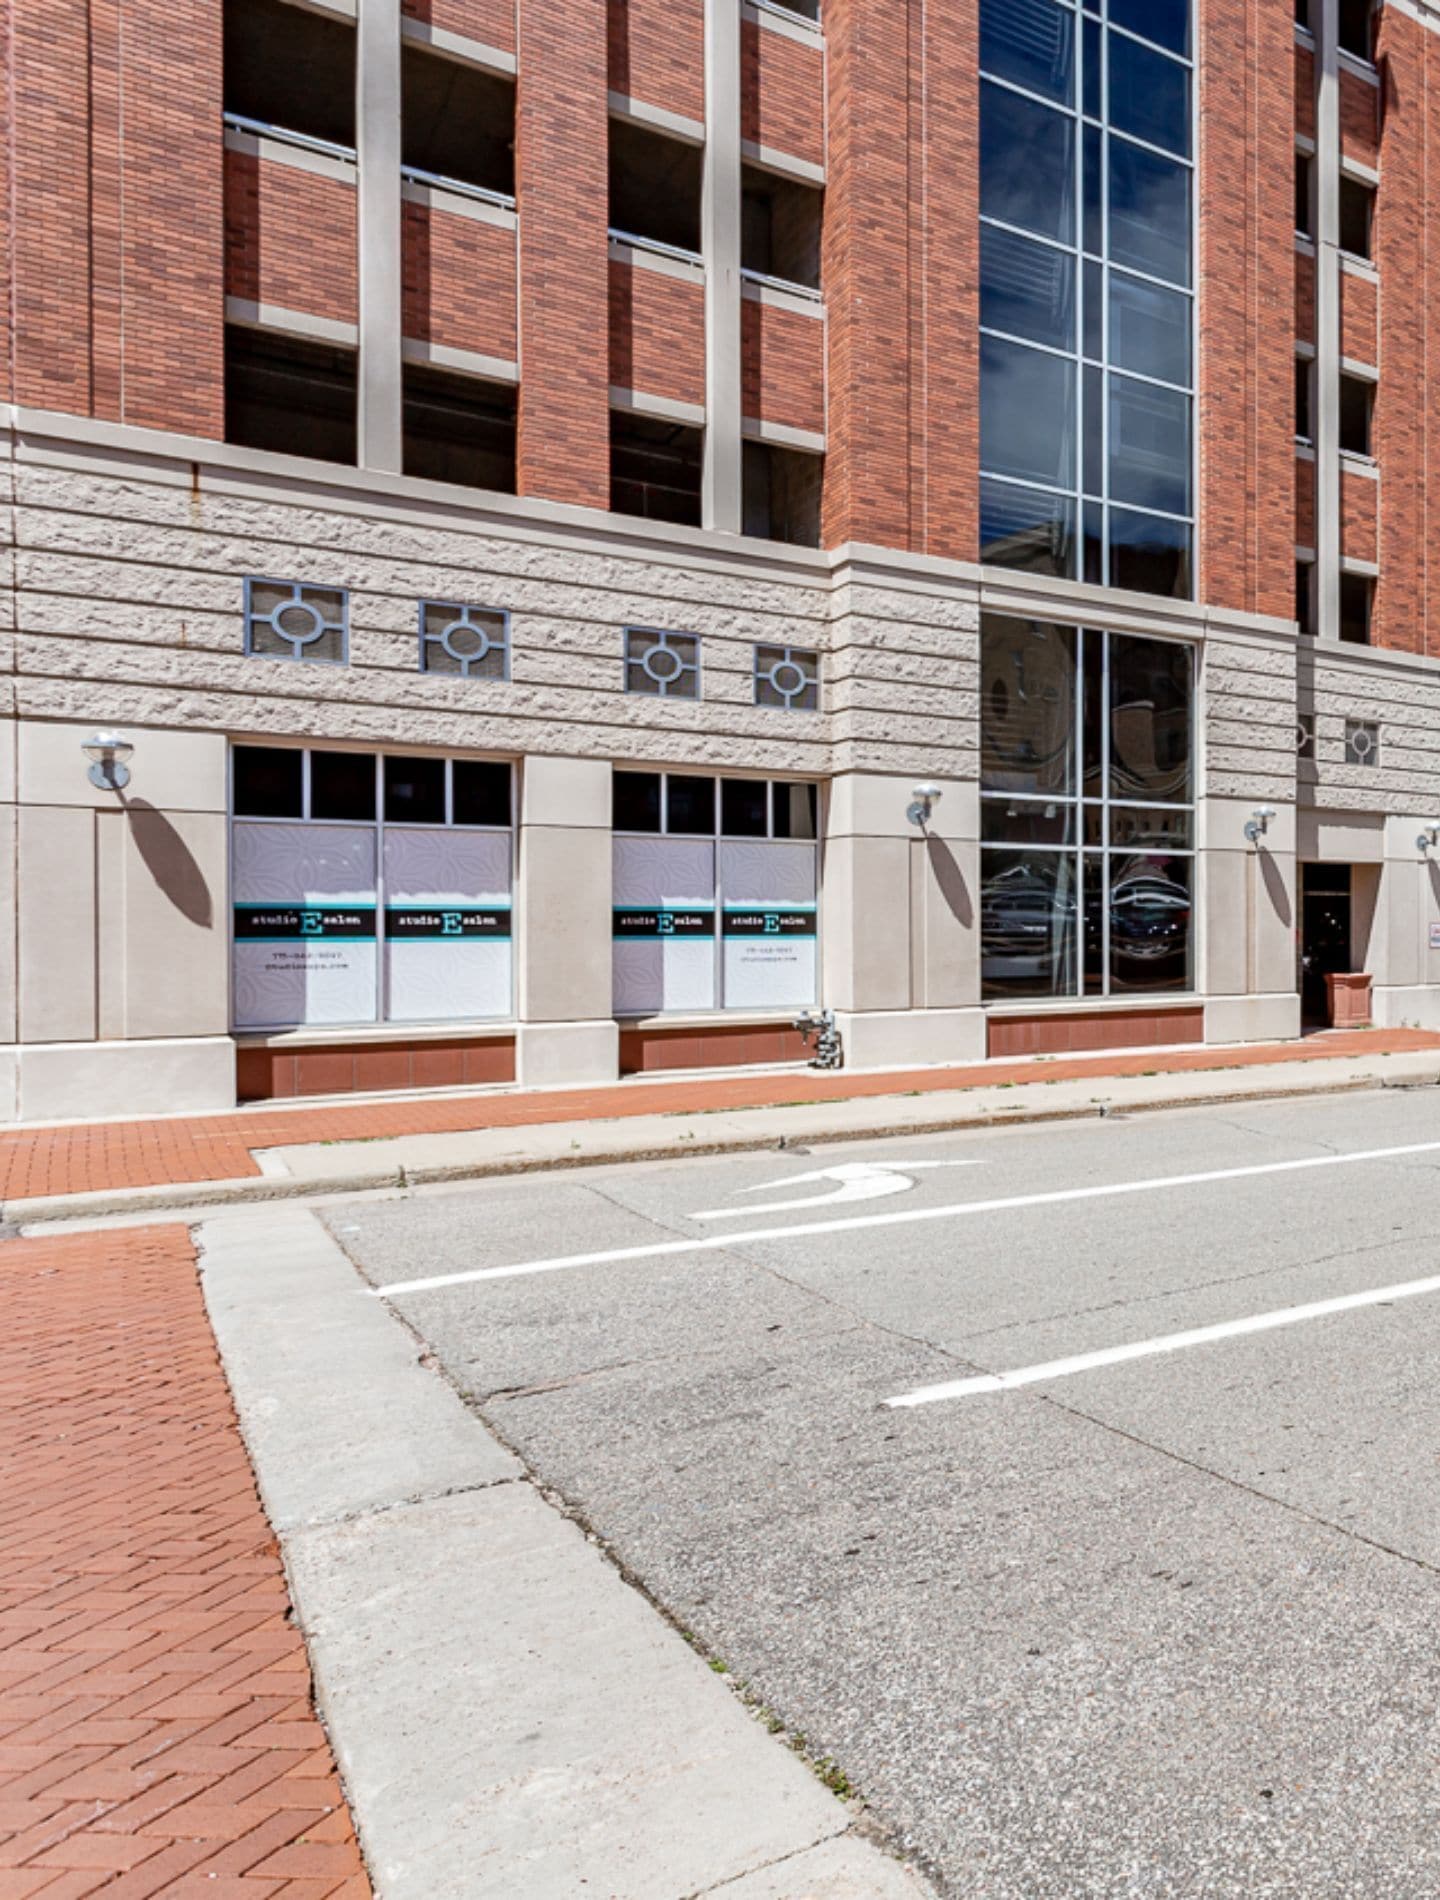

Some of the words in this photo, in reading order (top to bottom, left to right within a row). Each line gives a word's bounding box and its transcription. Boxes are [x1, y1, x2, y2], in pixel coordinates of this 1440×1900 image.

[252, 914, 298, 925] studio
[300, 912, 322, 934] E
[399, 915, 440, 926] studio
[442, 913, 462, 934] E
[621, 916, 656, 926] studio
[657, 913, 674, 934] E
[732, 916, 763, 926] studio
[764, 914, 780, 932] E
